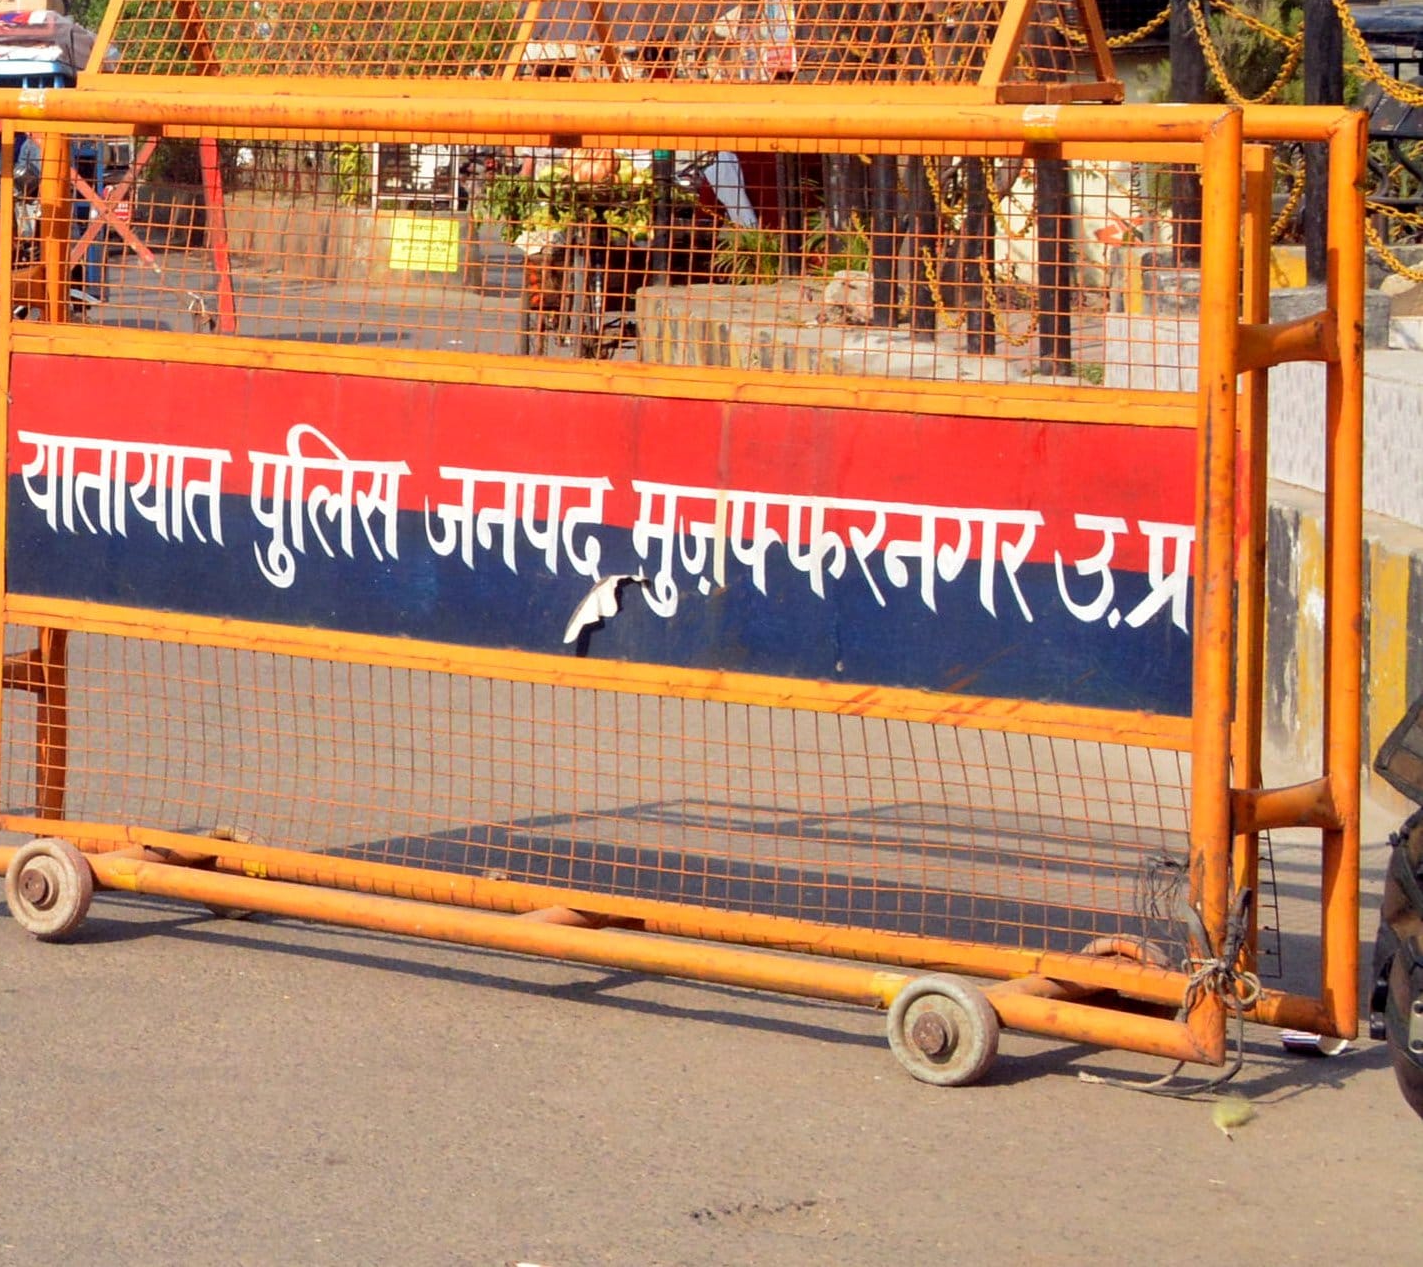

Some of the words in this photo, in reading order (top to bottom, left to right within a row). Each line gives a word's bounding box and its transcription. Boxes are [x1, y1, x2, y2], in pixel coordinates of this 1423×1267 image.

[17, 430, 233, 549] यातायात
[248, 422, 411, 589] पुलिस
[424, 465, 614, 583] जनपद
